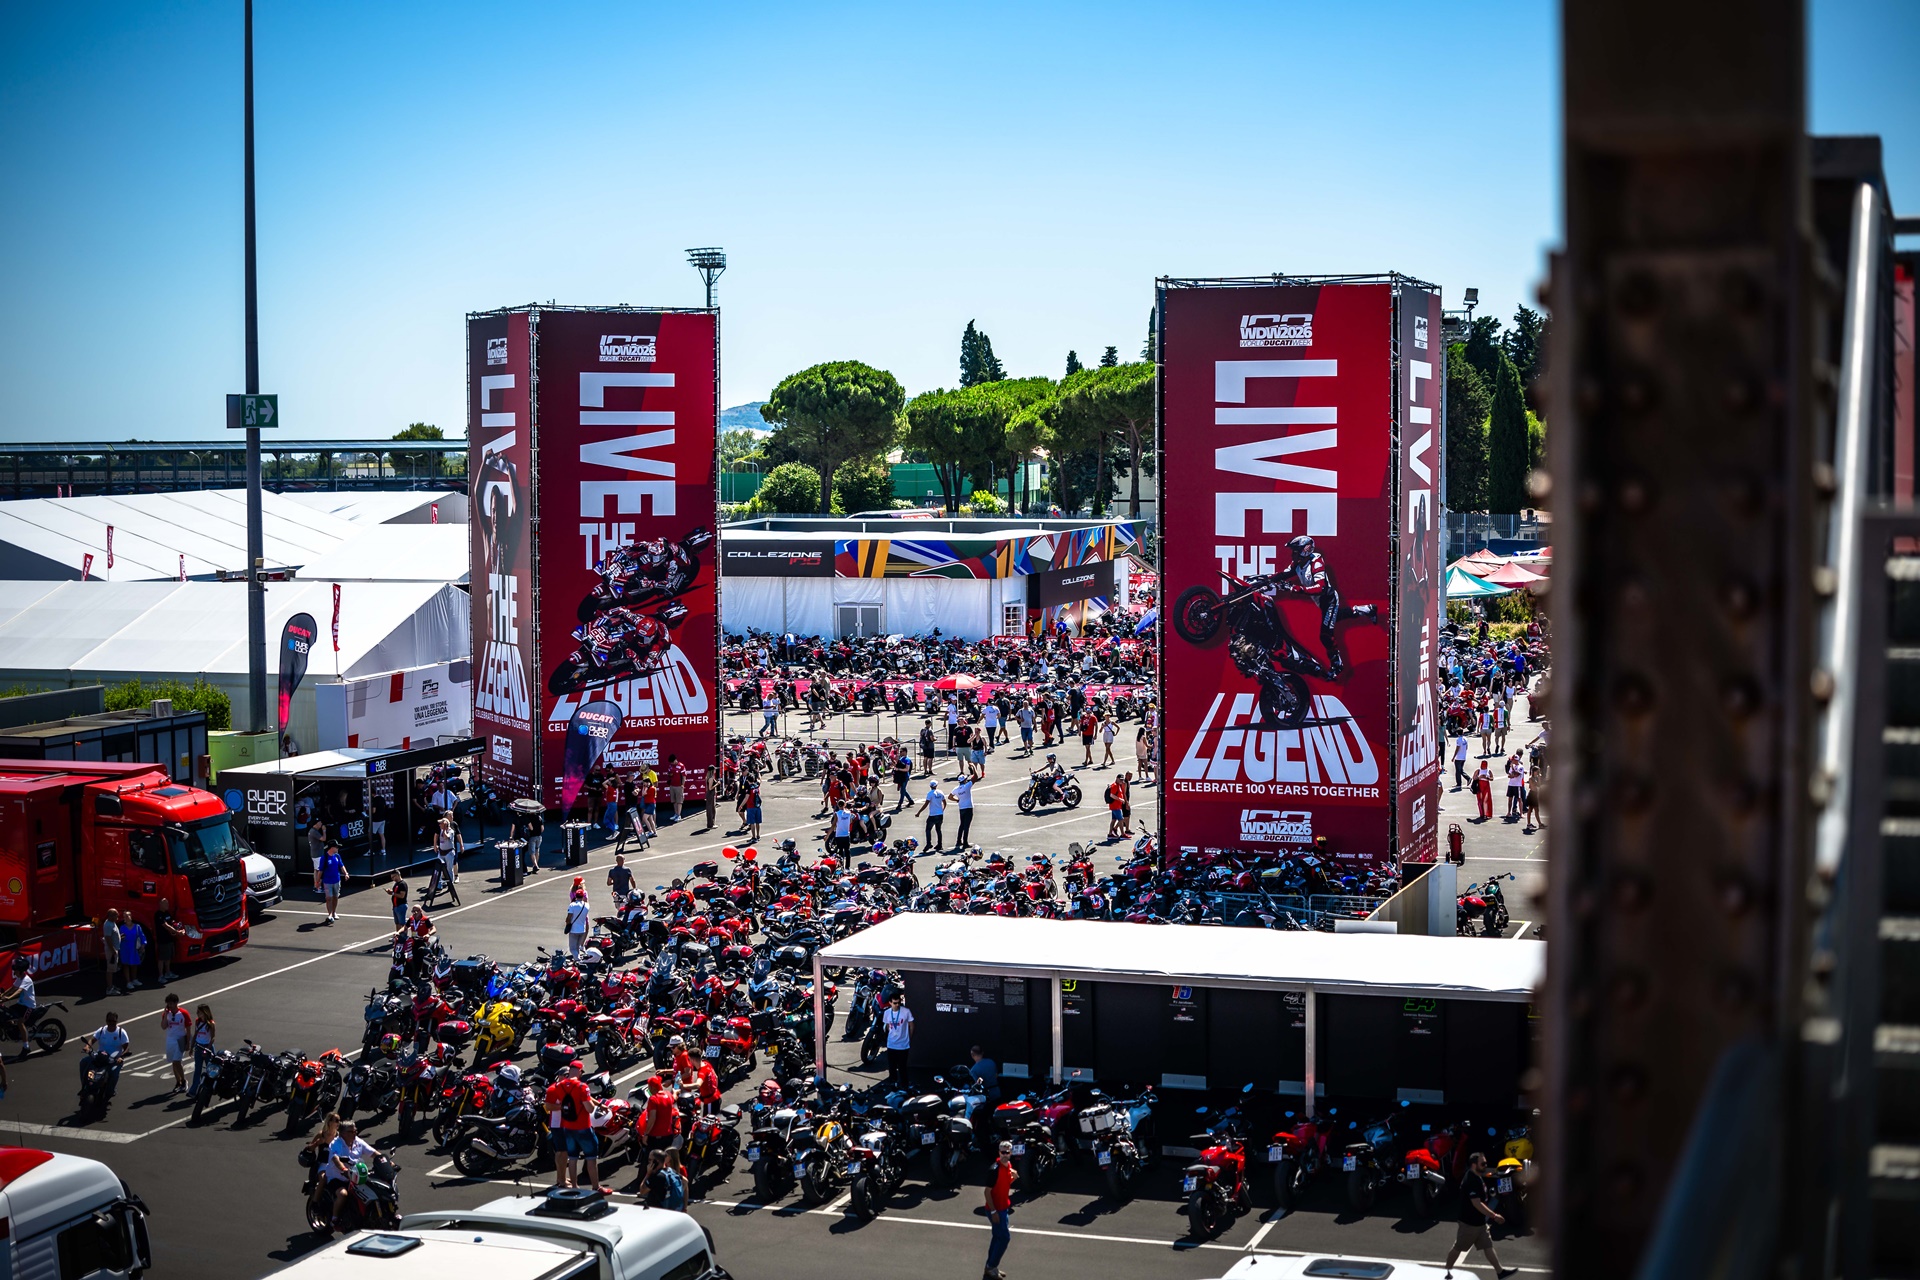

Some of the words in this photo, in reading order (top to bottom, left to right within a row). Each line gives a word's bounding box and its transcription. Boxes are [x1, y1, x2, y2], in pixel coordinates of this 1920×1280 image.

[1240, 326, 1312, 339] WDW2026
[600, 345, 656, 356] WDW2026
[580, 372, 676, 518] LIVE
[1215, 360, 1338, 537] LIVE
[1409, 360, 1432, 534] LIVE
[1215, 546, 1276, 597] THE
[1062, 574, 1095, 586] COLLEZIONE
[489, 574, 518, 644] THE
[1420, 618, 1430, 681] THE
[476, 641, 530, 720] LEGEND
[579, 712, 614, 724] DUCATI
[624, 719, 656, 728] YEARS
[658, 716, 709, 726] TOGETHER
[1174, 693, 1380, 784] LEGEND
[603, 750, 658, 760] WDW2026
[248, 789, 286, 803] QUAD
[1174, 782, 1242, 793] CELEBRATE
[1246, 784, 1265, 794] 100
[1268, 784, 1309, 795] YEARS
[1312, 786, 1380, 798] TOGETHER
[248, 801, 286, 815] LOCK
[348, 820, 363, 829] QUAD
[1240, 822, 1312, 834] WDW2026
[348, 828, 364, 837] LOCK
[12, 942, 78, 977] UCATI
